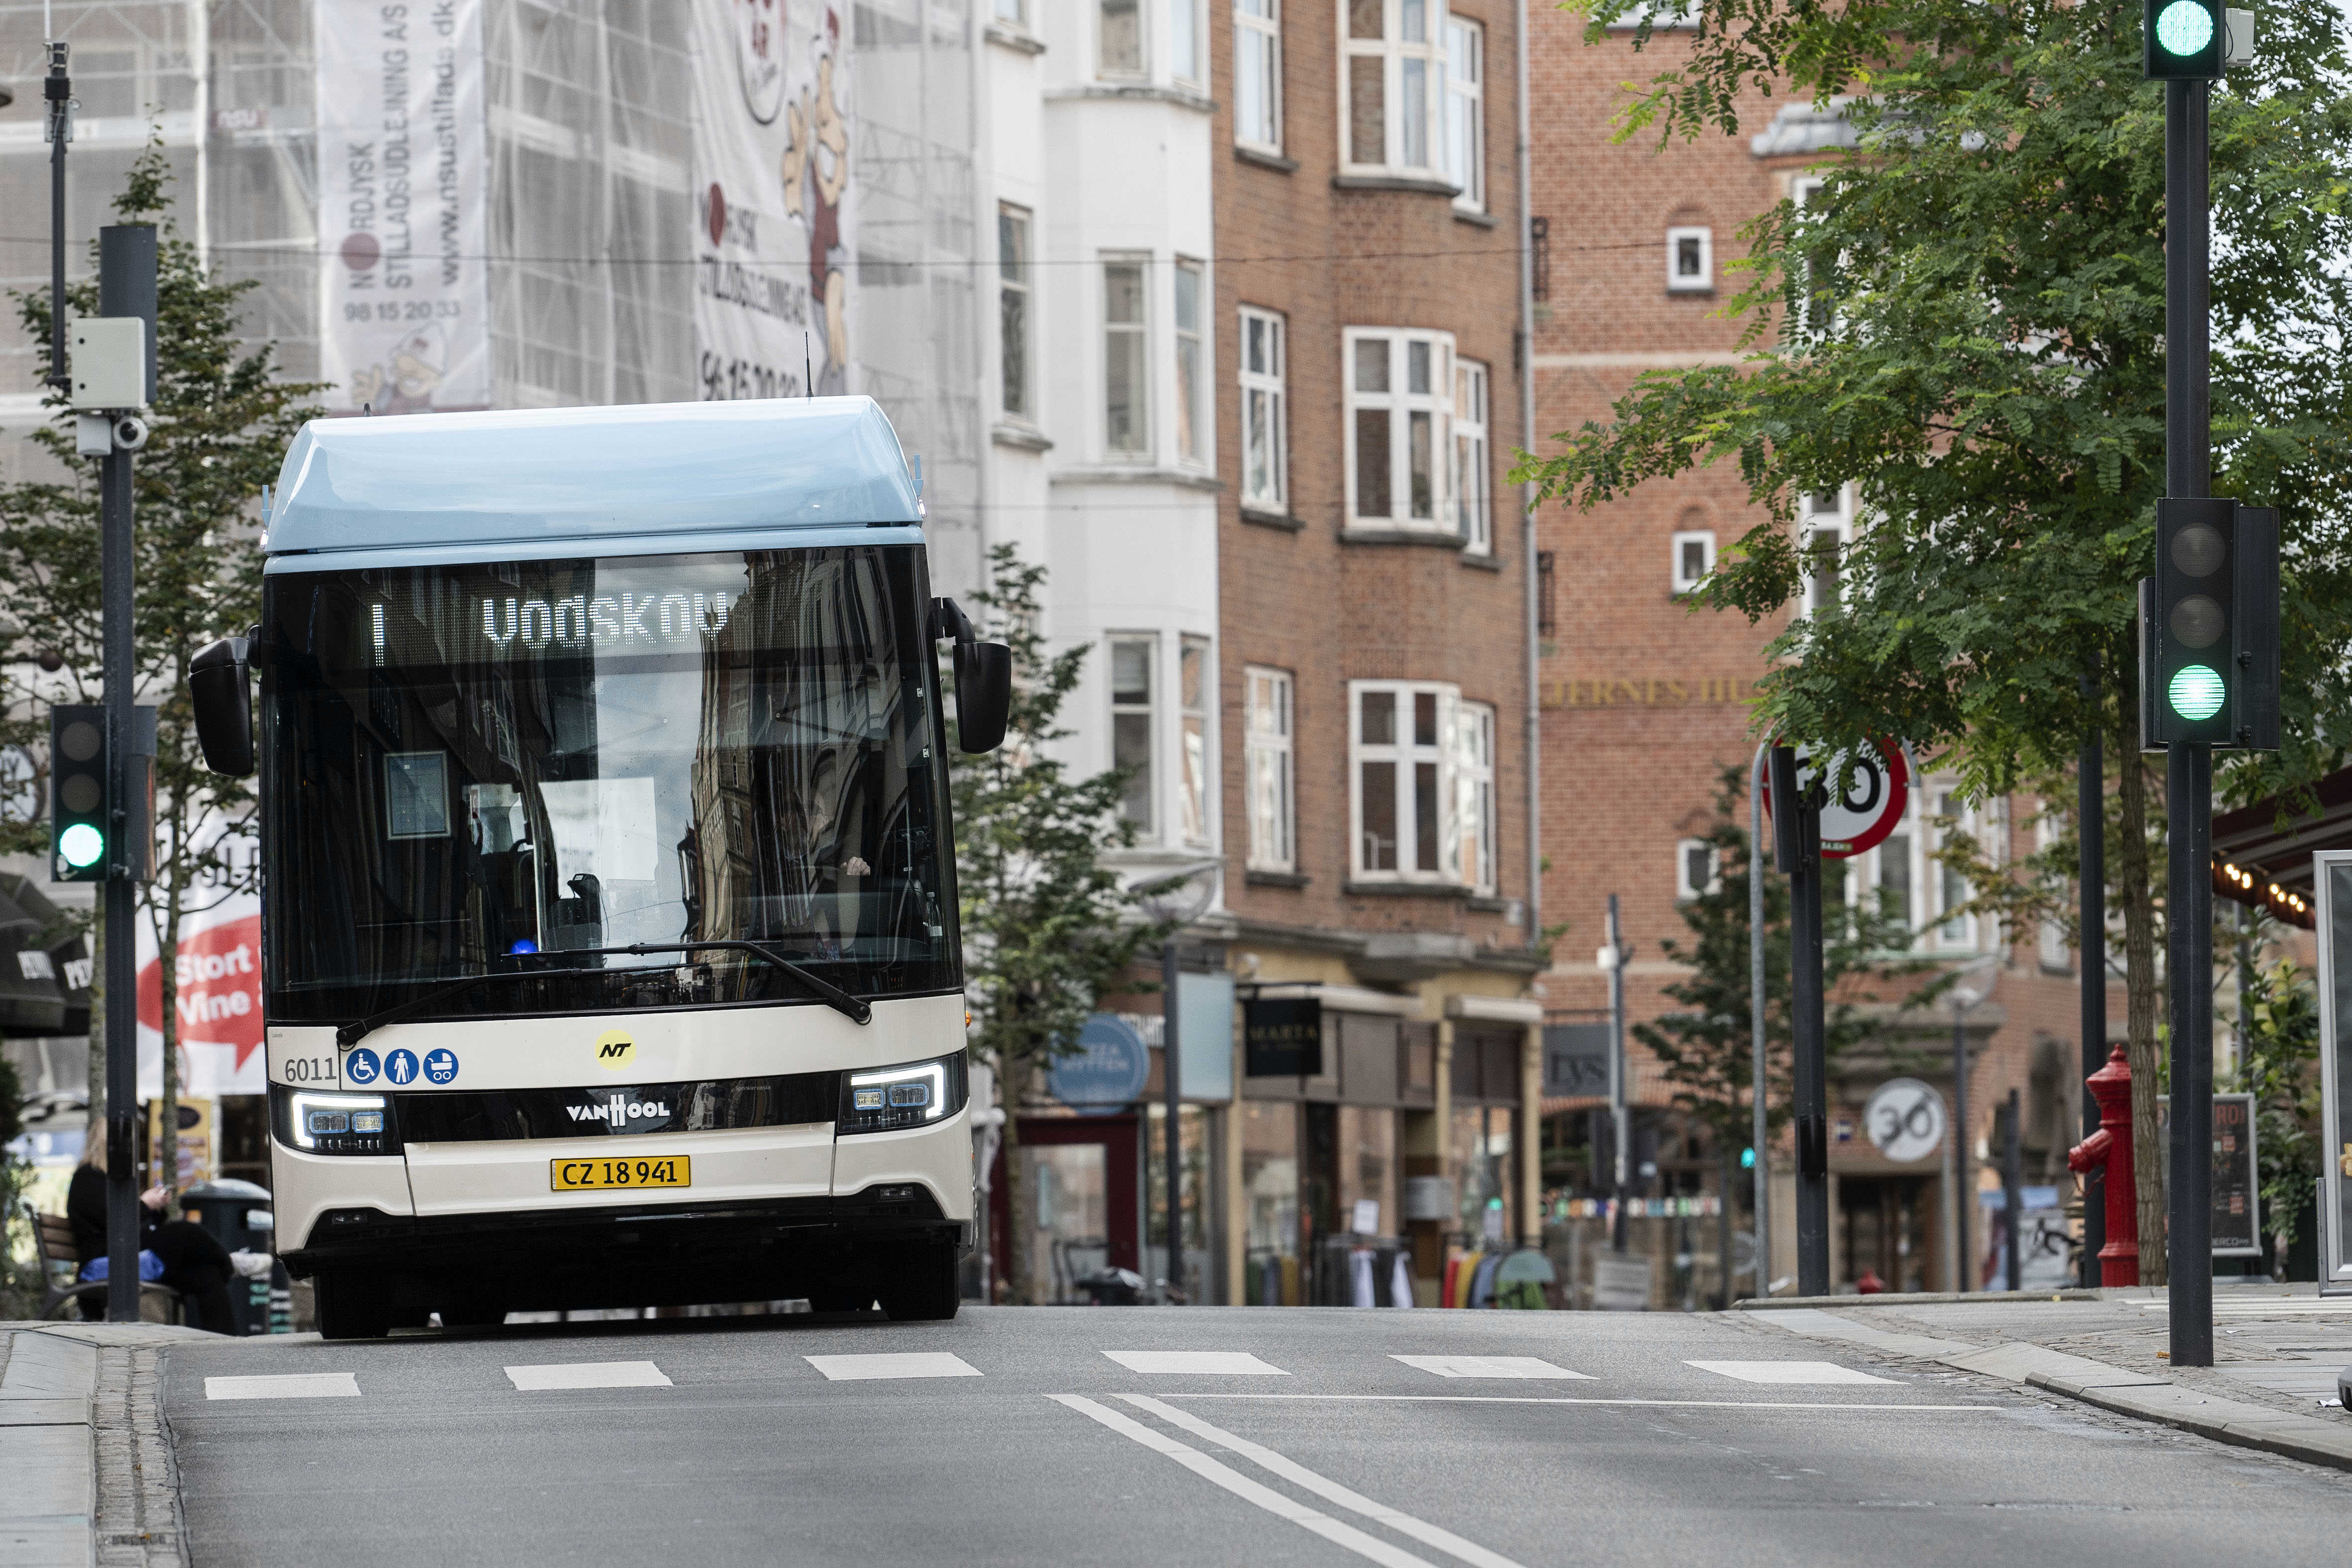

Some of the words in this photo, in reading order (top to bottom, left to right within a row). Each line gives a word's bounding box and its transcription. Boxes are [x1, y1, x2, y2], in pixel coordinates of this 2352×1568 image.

[175, 943, 253, 986] Stort
[176, 990, 251, 1026] Vine
[599, 1043, 631, 1058] NT
[285, 1057, 337, 1082] 6011
[1877, 1104, 1933, 1140] 30
[563, 1163, 594, 1185] CZ
[603, 1162, 630, 1184] 18
[636, 1161, 678, 1184] 941
